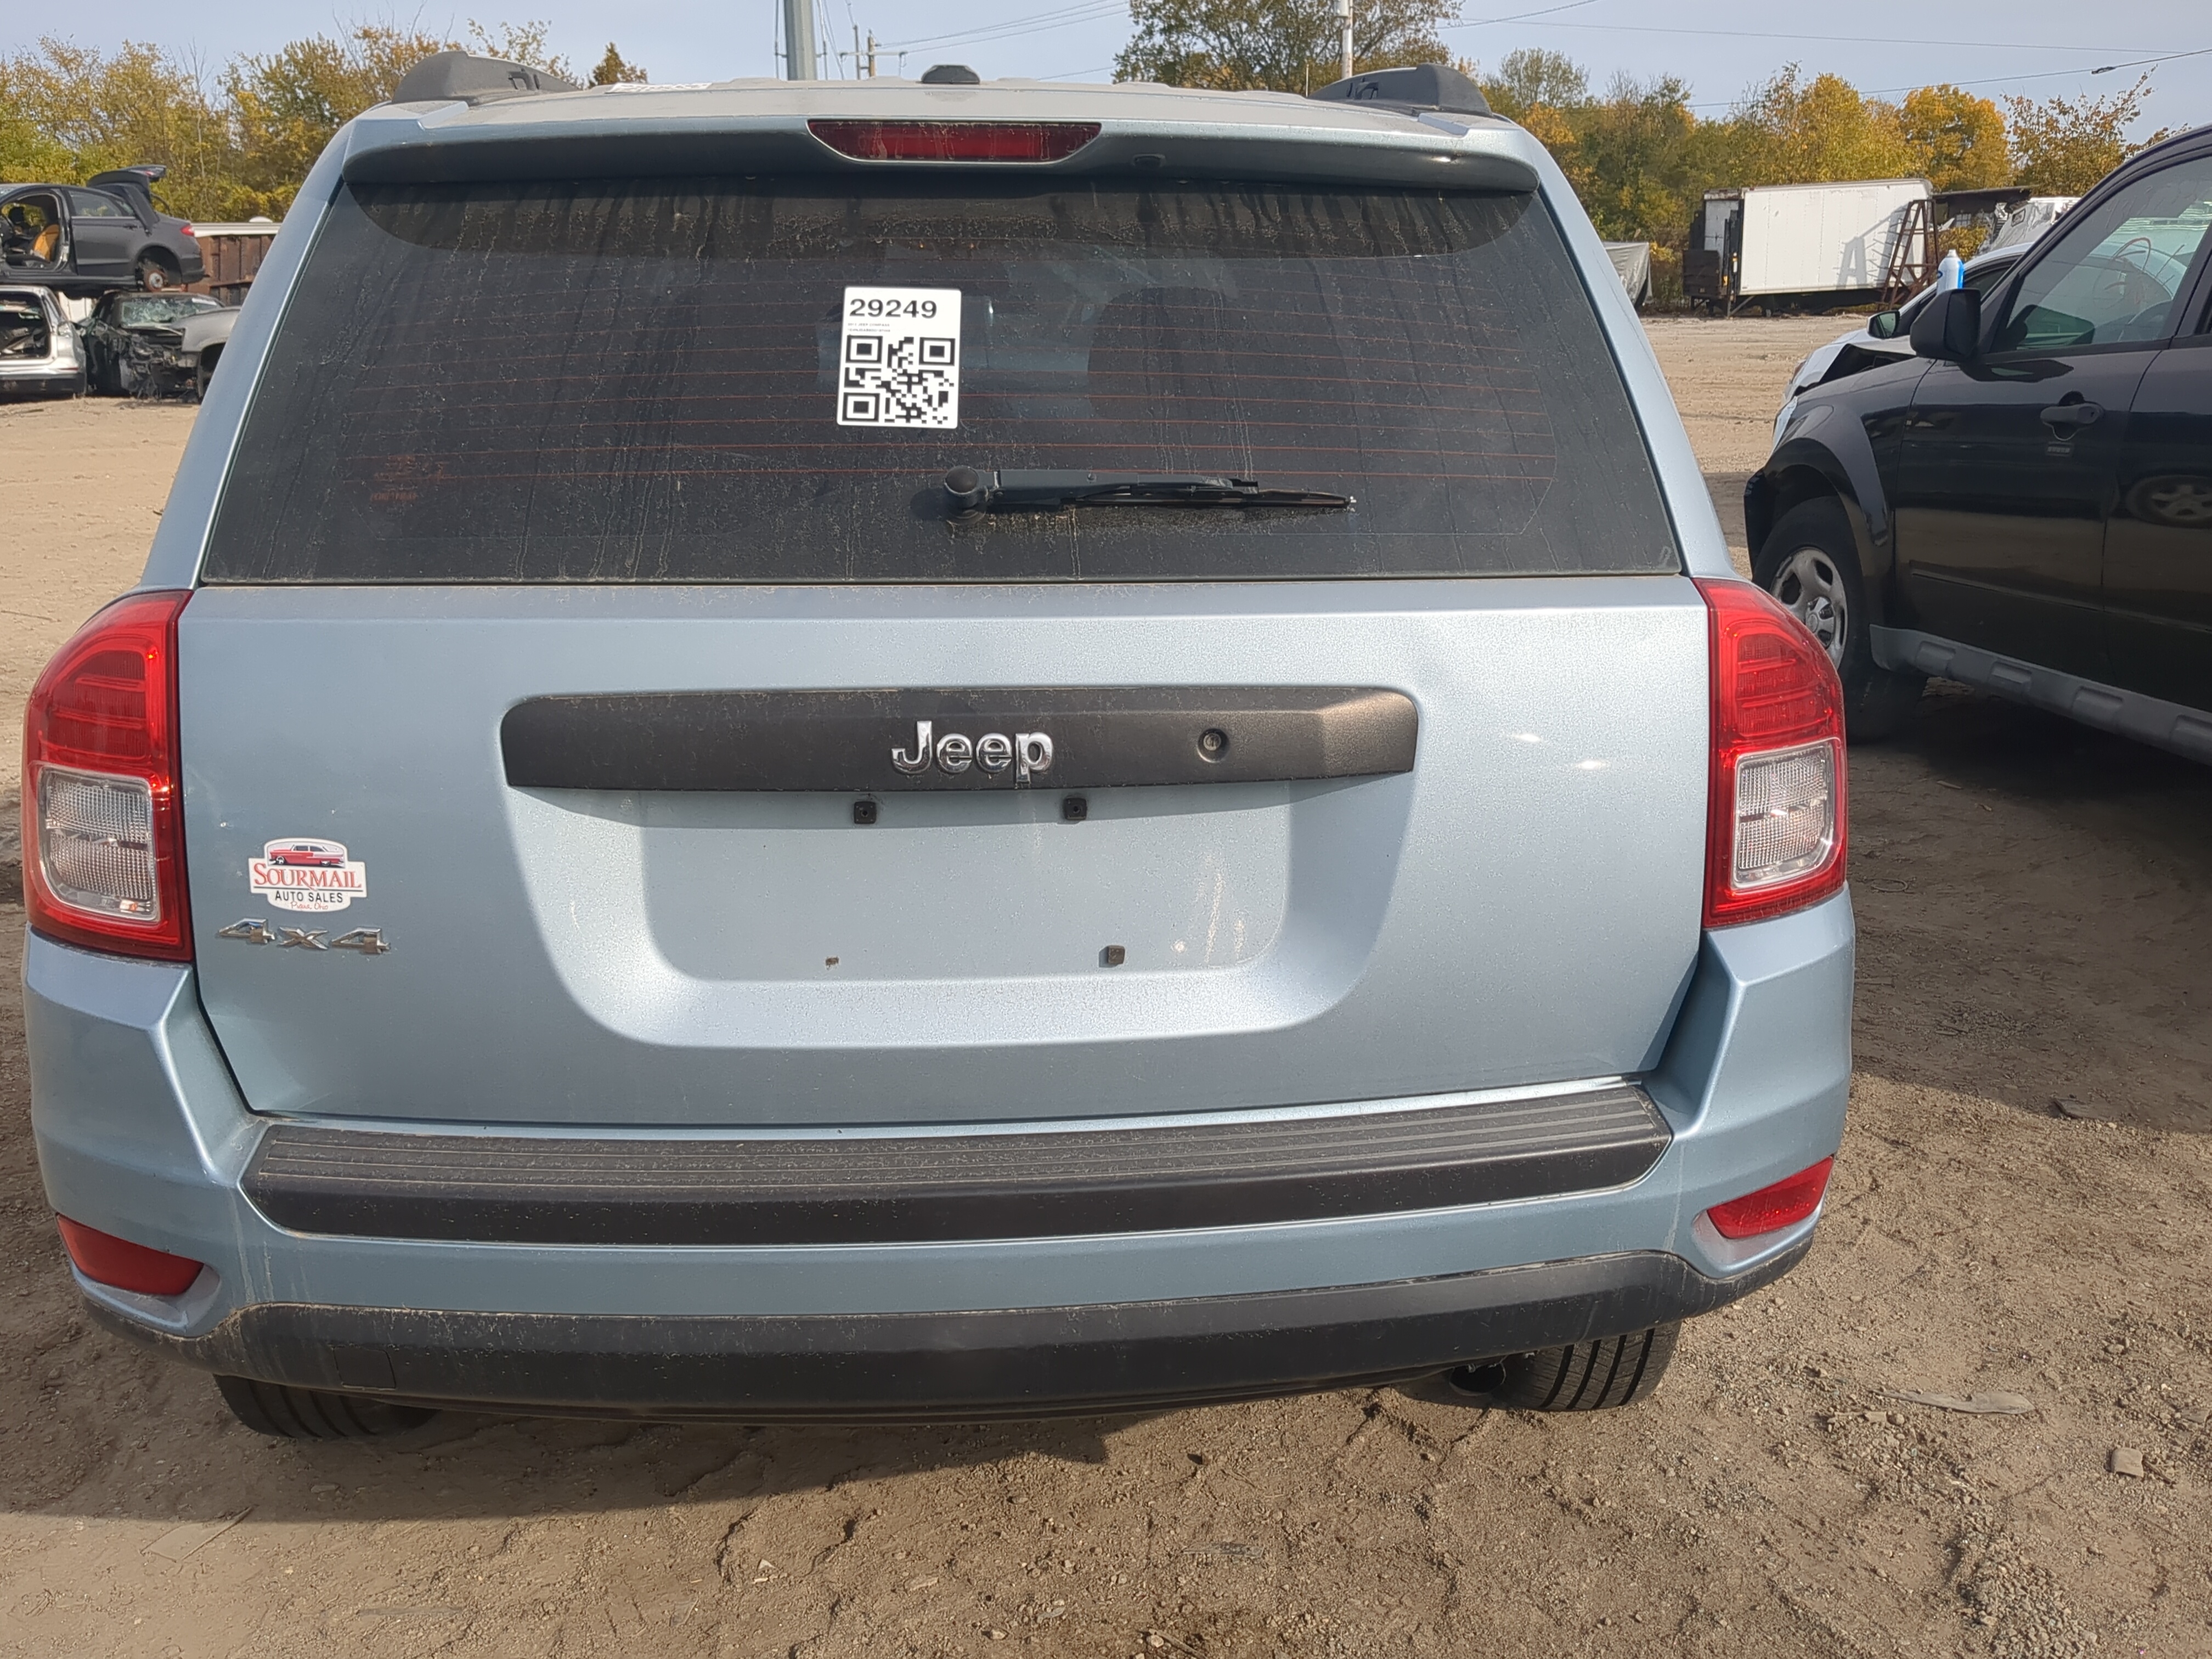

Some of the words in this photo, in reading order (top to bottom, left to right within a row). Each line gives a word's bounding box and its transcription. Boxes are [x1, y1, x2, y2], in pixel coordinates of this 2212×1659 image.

[849, 298, 937, 319] 29249
[891, 720, 1053, 783] Jeep
[253, 862, 362, 890] SOURMAIL
[275, 890, 304, 902] AUTO
[308, 892, 343, 903] SALES
